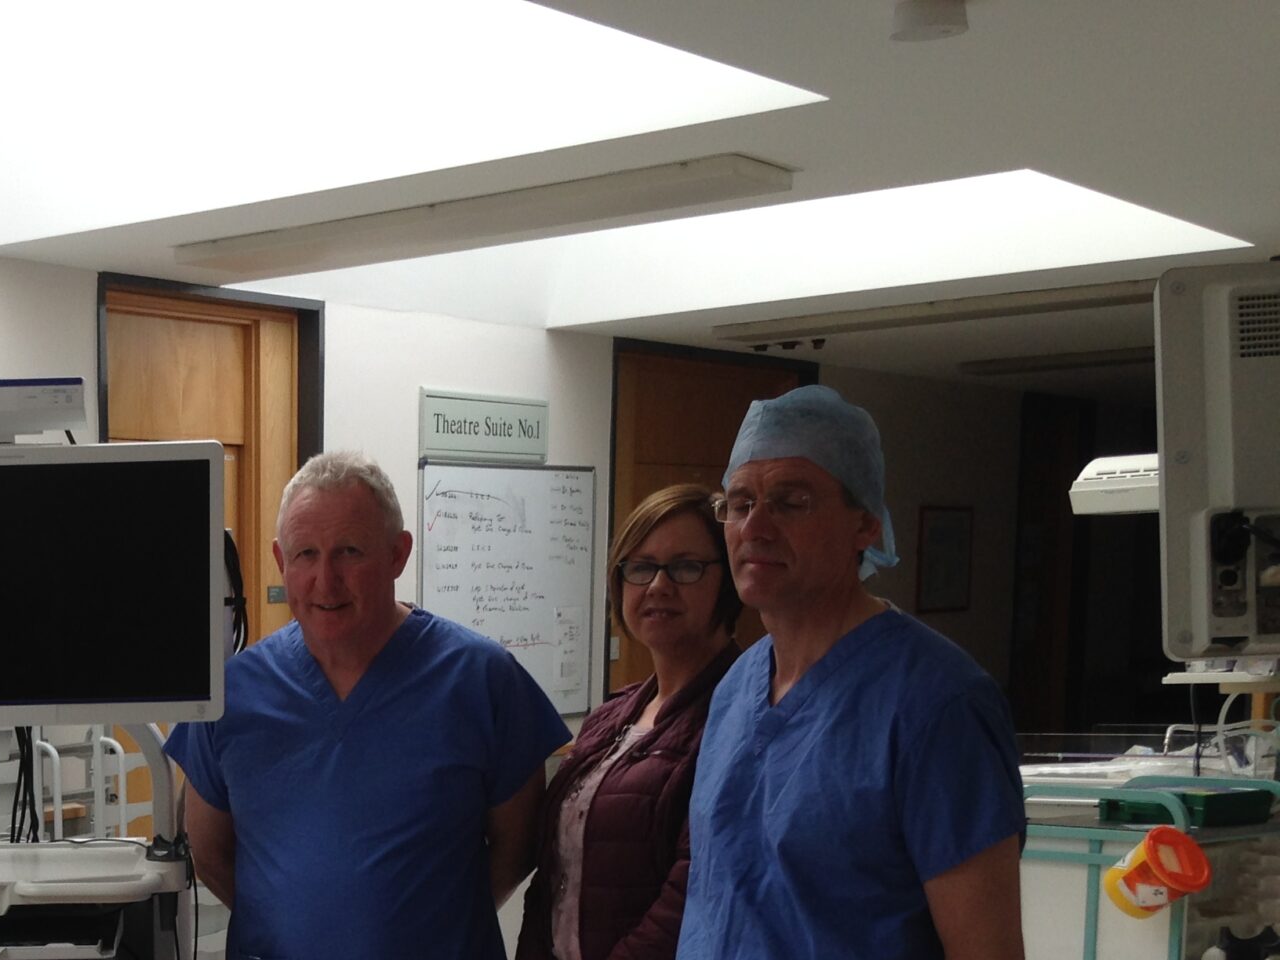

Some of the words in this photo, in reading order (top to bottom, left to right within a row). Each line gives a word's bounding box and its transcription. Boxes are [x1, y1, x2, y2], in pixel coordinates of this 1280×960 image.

[433, 413, 480, 436] Theatre
[484, 416, 513, 438] Suite
[518, 419, 540, 440] No.1
